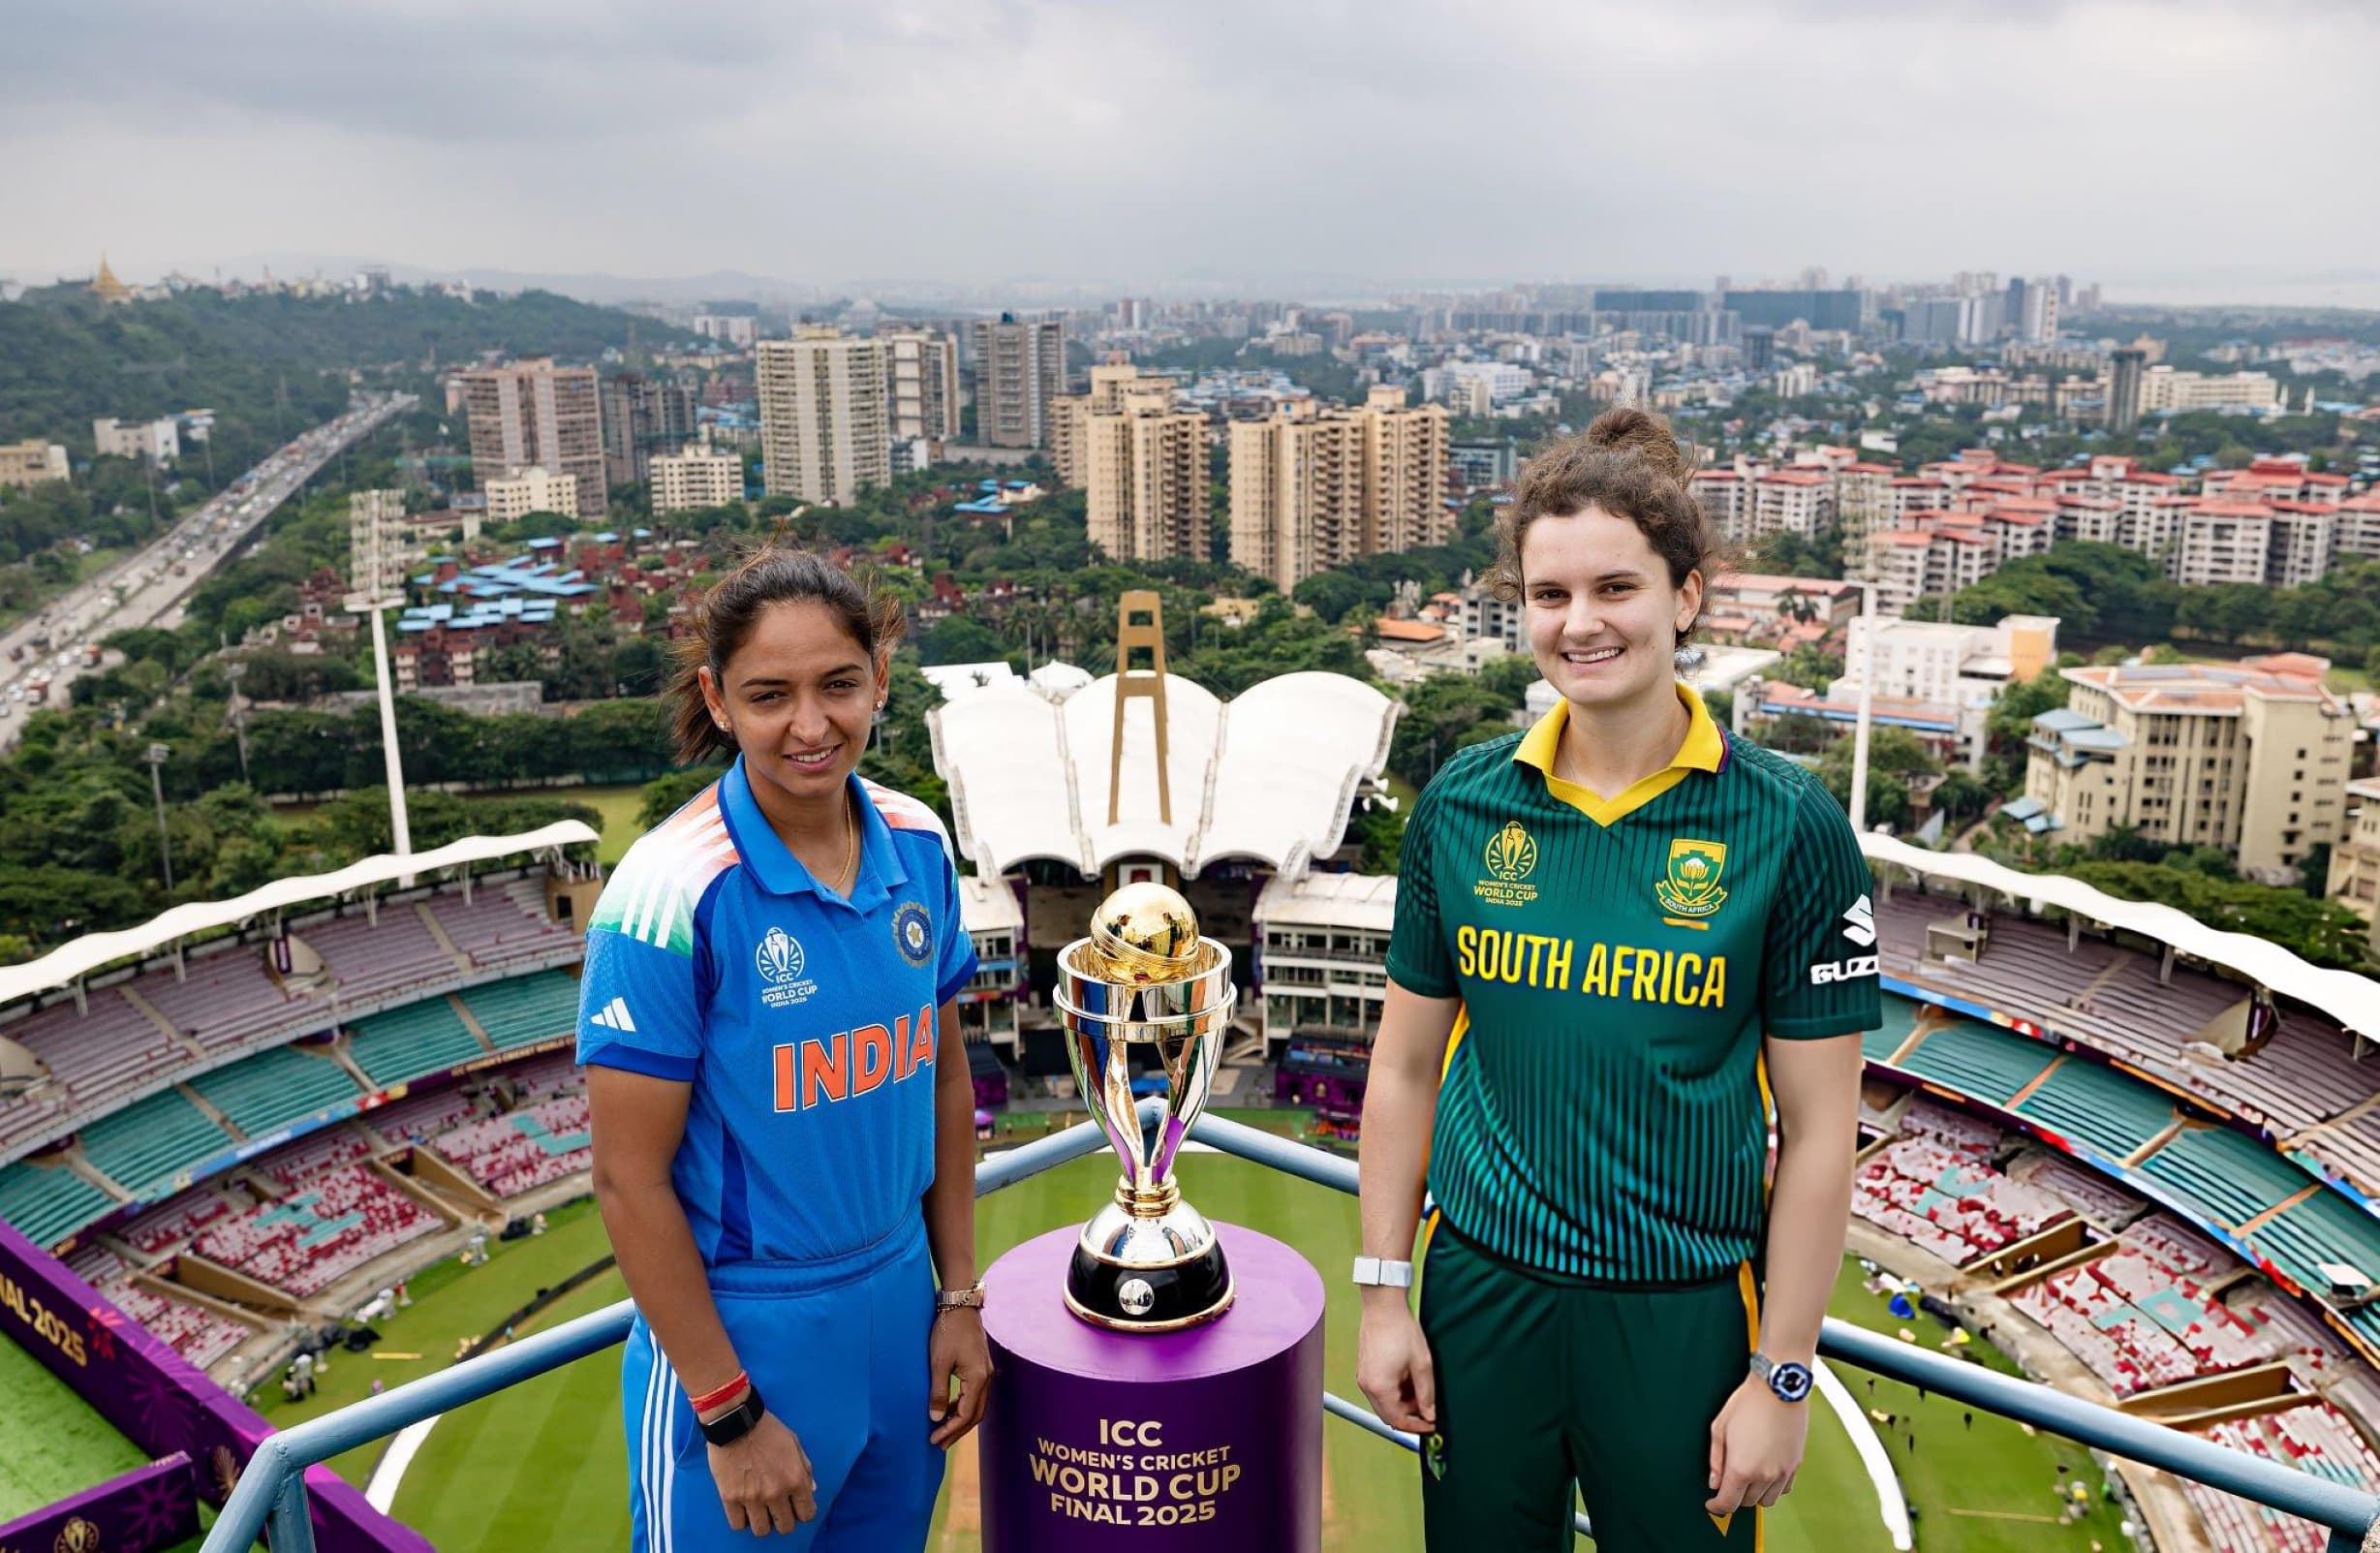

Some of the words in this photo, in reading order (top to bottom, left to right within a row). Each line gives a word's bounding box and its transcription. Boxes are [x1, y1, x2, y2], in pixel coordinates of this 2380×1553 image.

[1499, 871, 1518, 881] ICC
[1473, 885, 1514, 899] WORLD
[1516, 890, 1538, 901] CUP
[1665, 898, 1687, 913] SOUTH
[1688, 904, 1715, 914] AFRICA
[775, 973, 794, 983] ICC
[1457, 925, 1573, 990] SOUTH
[1582, 943, 1726, 1009] AFRICA
[797, 984, 818, 996] CUP
[774, 1004, 934, 1112] INDIA
[29, 1297, 88, 1367] 2025
[1099, 1418, 1162, 1447] ICC
[1037, 1437, 1134, 1471] WOMEN'S
[1140, 1445, 1230, 1471] CRICKET
[1029, 1453, 1159, 1502] WORLD
[1169, 1464, 1241, 1501] CUP
[1050, 1493, 1131, 1526] FINAL
[1137, 1500, 1216, 1527] 2025
